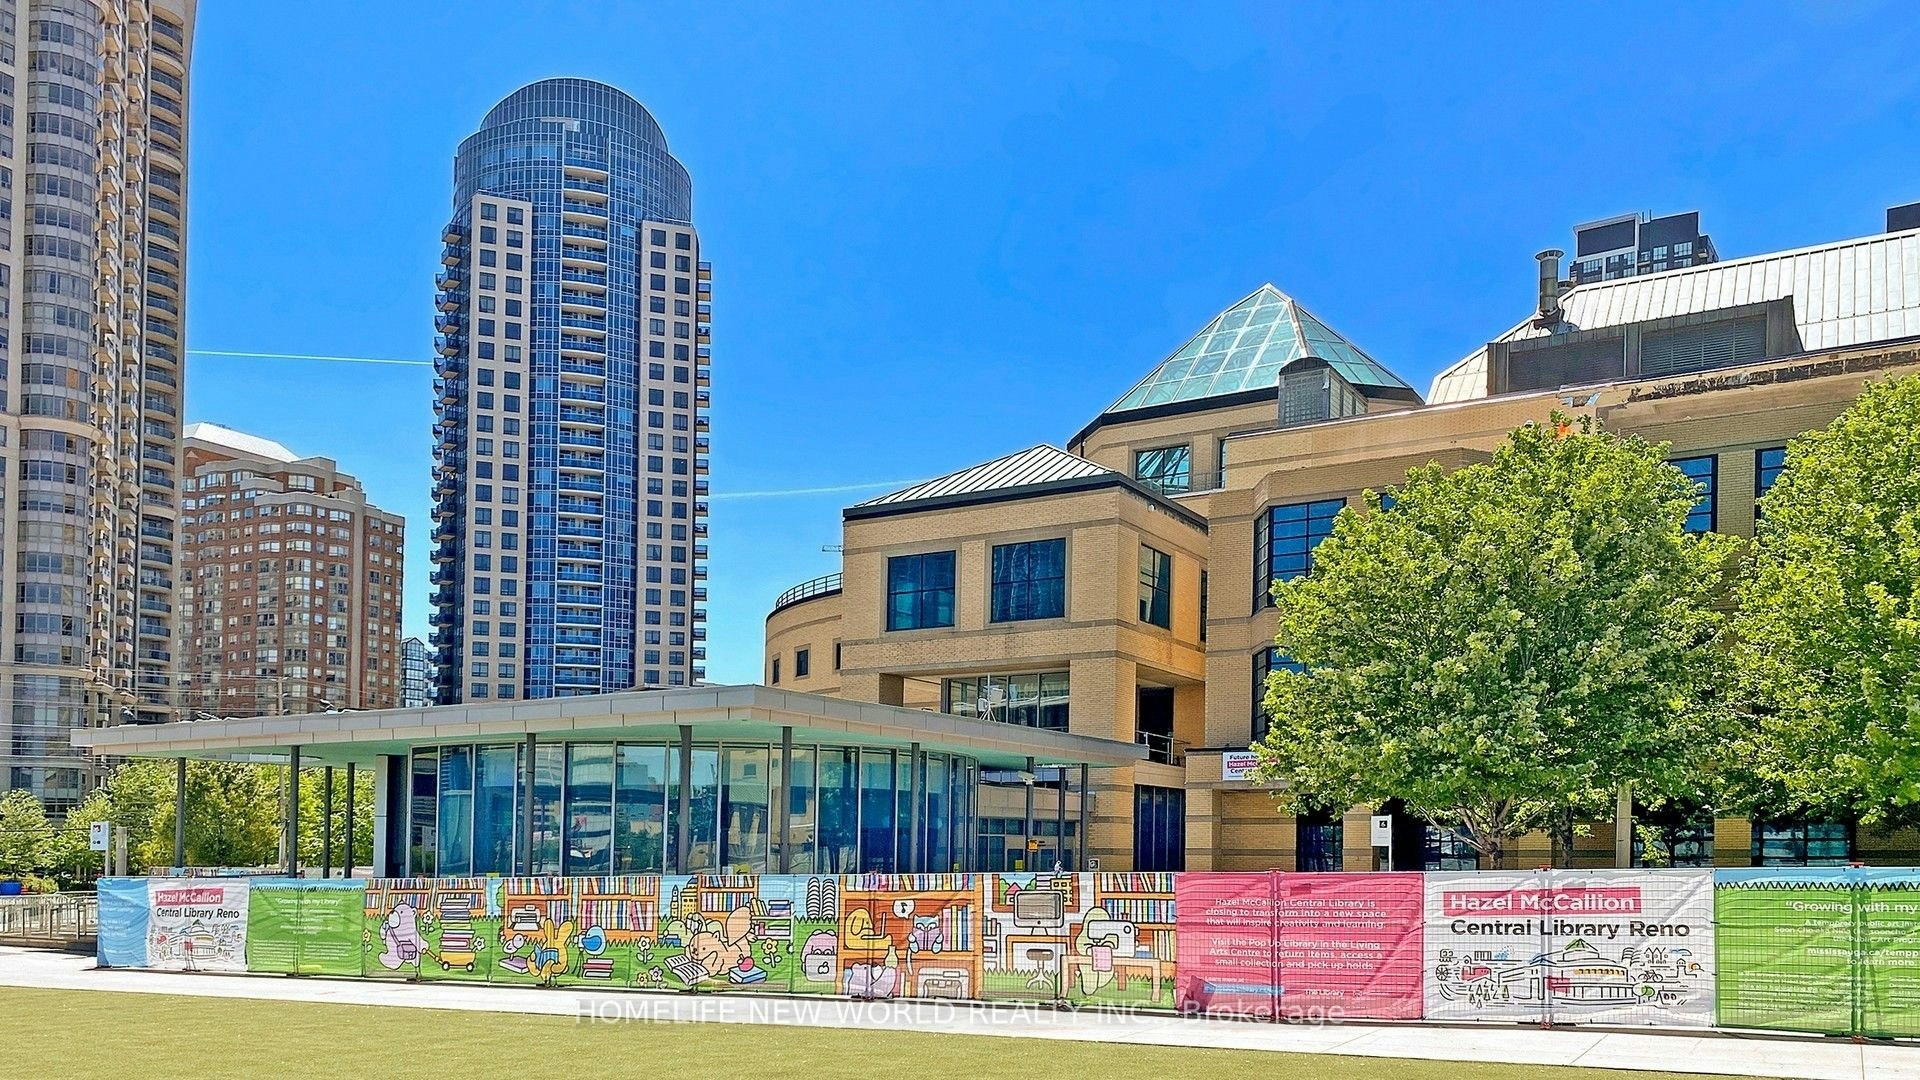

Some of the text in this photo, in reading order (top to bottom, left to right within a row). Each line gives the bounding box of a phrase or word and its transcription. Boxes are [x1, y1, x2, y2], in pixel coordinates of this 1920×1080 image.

[157, 891, 221, 903] Hazel McCallion
[1451, 893, 1635, 912] Hazel McCallion
[1215, 898, 1376, 909] Hazel McCallion Central Library is
[1858, 901, 1889, 913] with
[1895, 903, 1918, 914] my
[157, 907, 240, 919] Central Library Reno
[1205, 908, 1238, 917] closing
[1240, 908, 1250, 916] to
[1252, 909, 1298, 917] transform
[1301, 909, 1321, 917] into
[1357, 910, 1387, 919] space
[1206, 917, 1224, 926] that
[1226, 918, 1241, 926] will
[1243, 919, 1272, 927] inspire
[1274, 919, 1319, 928] creativity
[1322, 919, 1341, 928] and
[1450, 919, 1690, 939] Central Library Reno
[1212, 938, 1380, 950] Visit the Pop Up Library in the Living
[1209, 948, 1228, 956] Arts
[1230, 948, 1261, 957] Centre
[1263, 949, 1272, 957] to
[1340, 951, 1373, 959] access
[1215, 958, 1238, 967] small
[1240, 959, 1284, 968] collection
[1286, 959, 1305, 968] and
